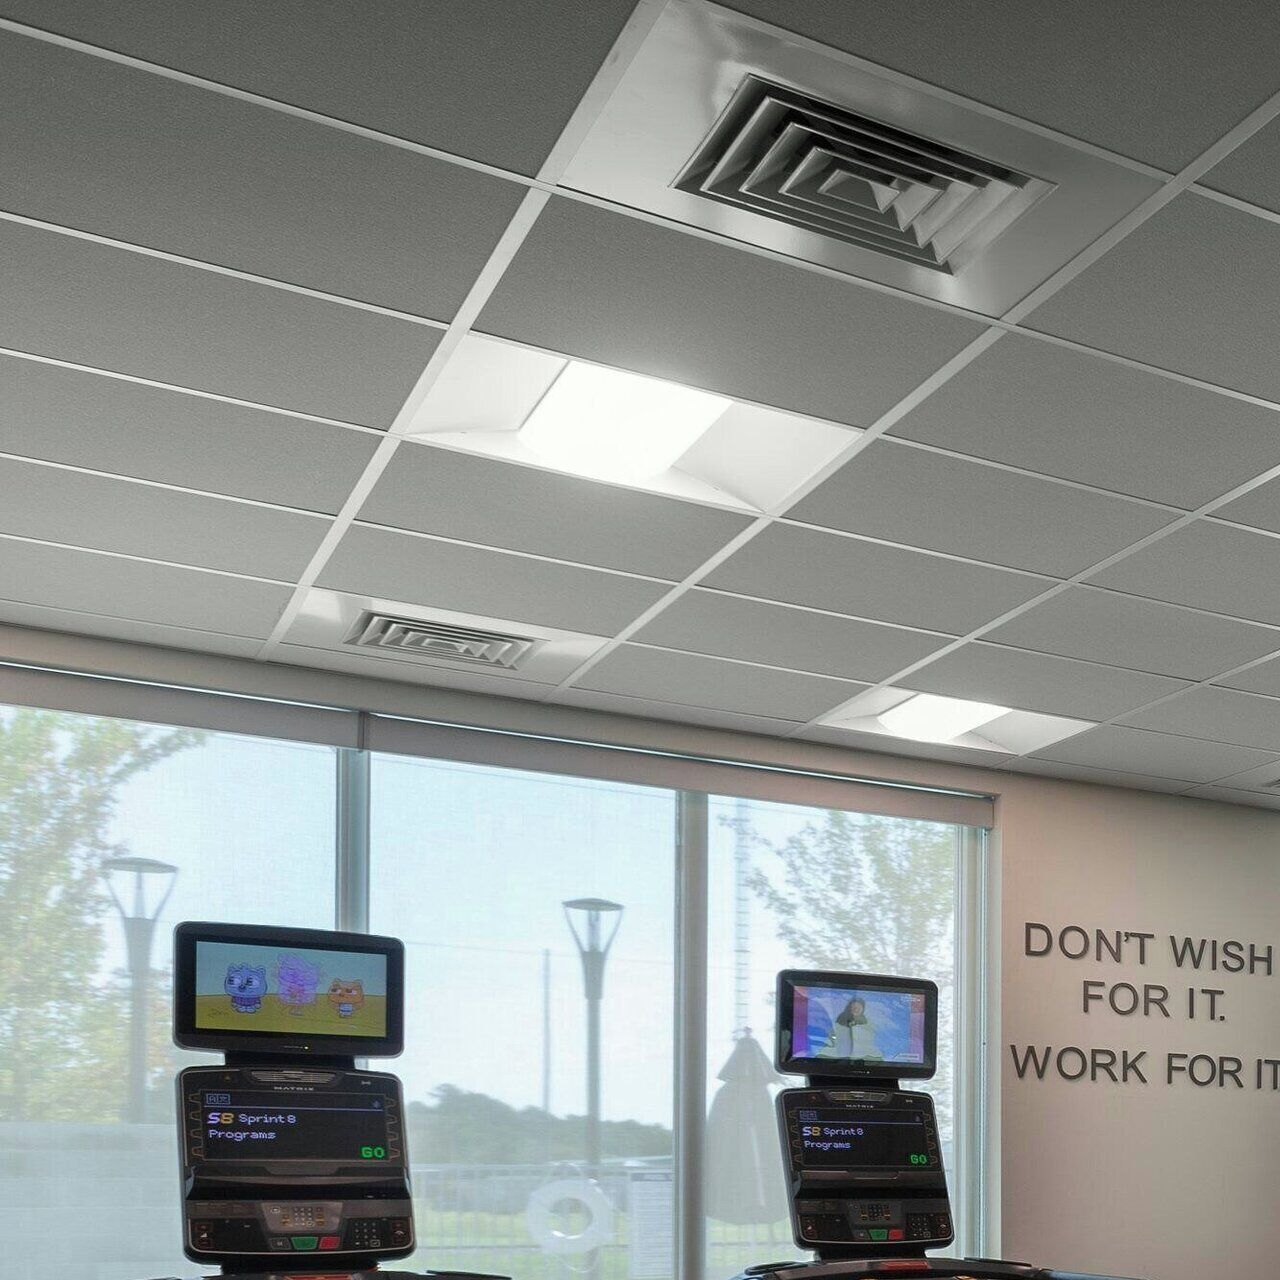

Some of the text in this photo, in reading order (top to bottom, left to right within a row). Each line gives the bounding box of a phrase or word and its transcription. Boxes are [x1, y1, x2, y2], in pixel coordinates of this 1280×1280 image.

[1024, 922, 1273, 976] DON'T WISH
[1083, 980, 1226, 1022] FOR IT.
[1009, 1044, 1148, 1084] WORK
[1167, 1052, 1244, 1089] FOR
[239, 1113, 286, 1126] Sprint
[208, 1129, 276, 1141] Programs
[823, 1127, 856, 1136] Sprint
[804, 1140, 851, 1150] Programs
[361, 1147, 385, 1158] GO
